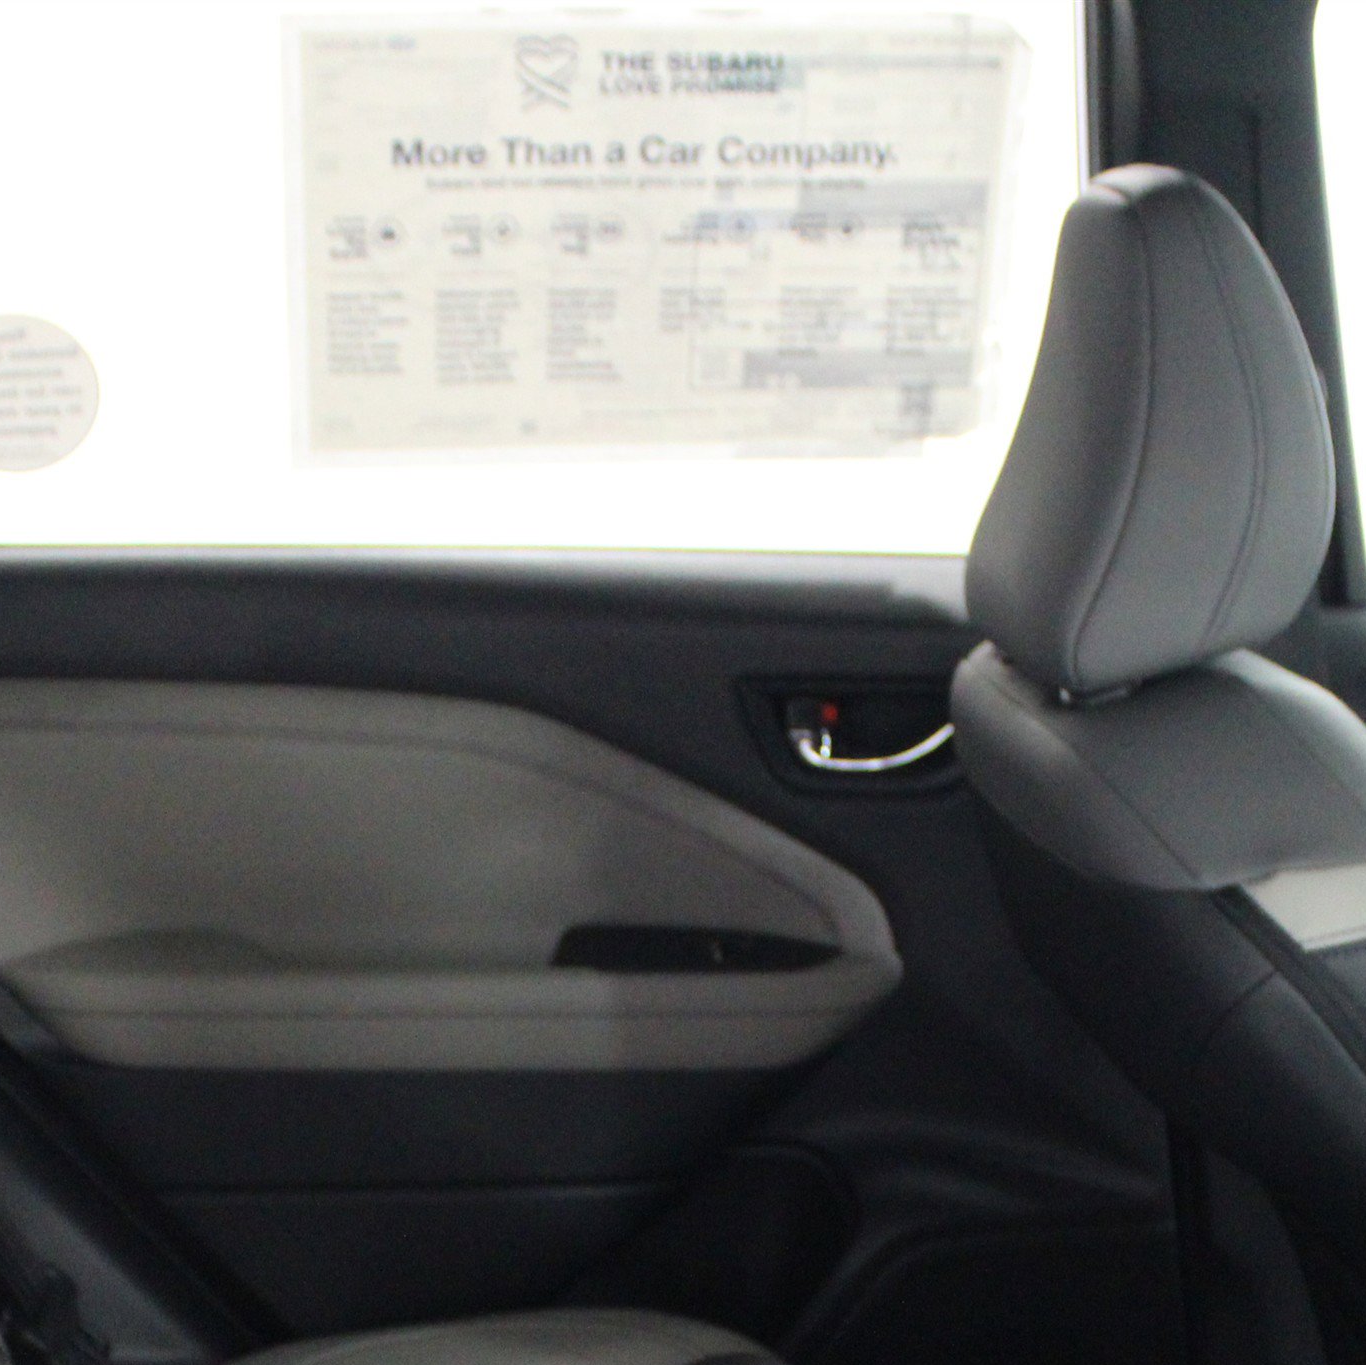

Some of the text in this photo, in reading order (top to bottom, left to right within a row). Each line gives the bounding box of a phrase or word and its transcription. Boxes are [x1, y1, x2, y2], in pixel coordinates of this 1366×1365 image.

[601, 51, 785, 73] THE SUBARU
[600, 75, 659, 95] LOVE
[390, 135, 897, 171] More Than a Car Company.
